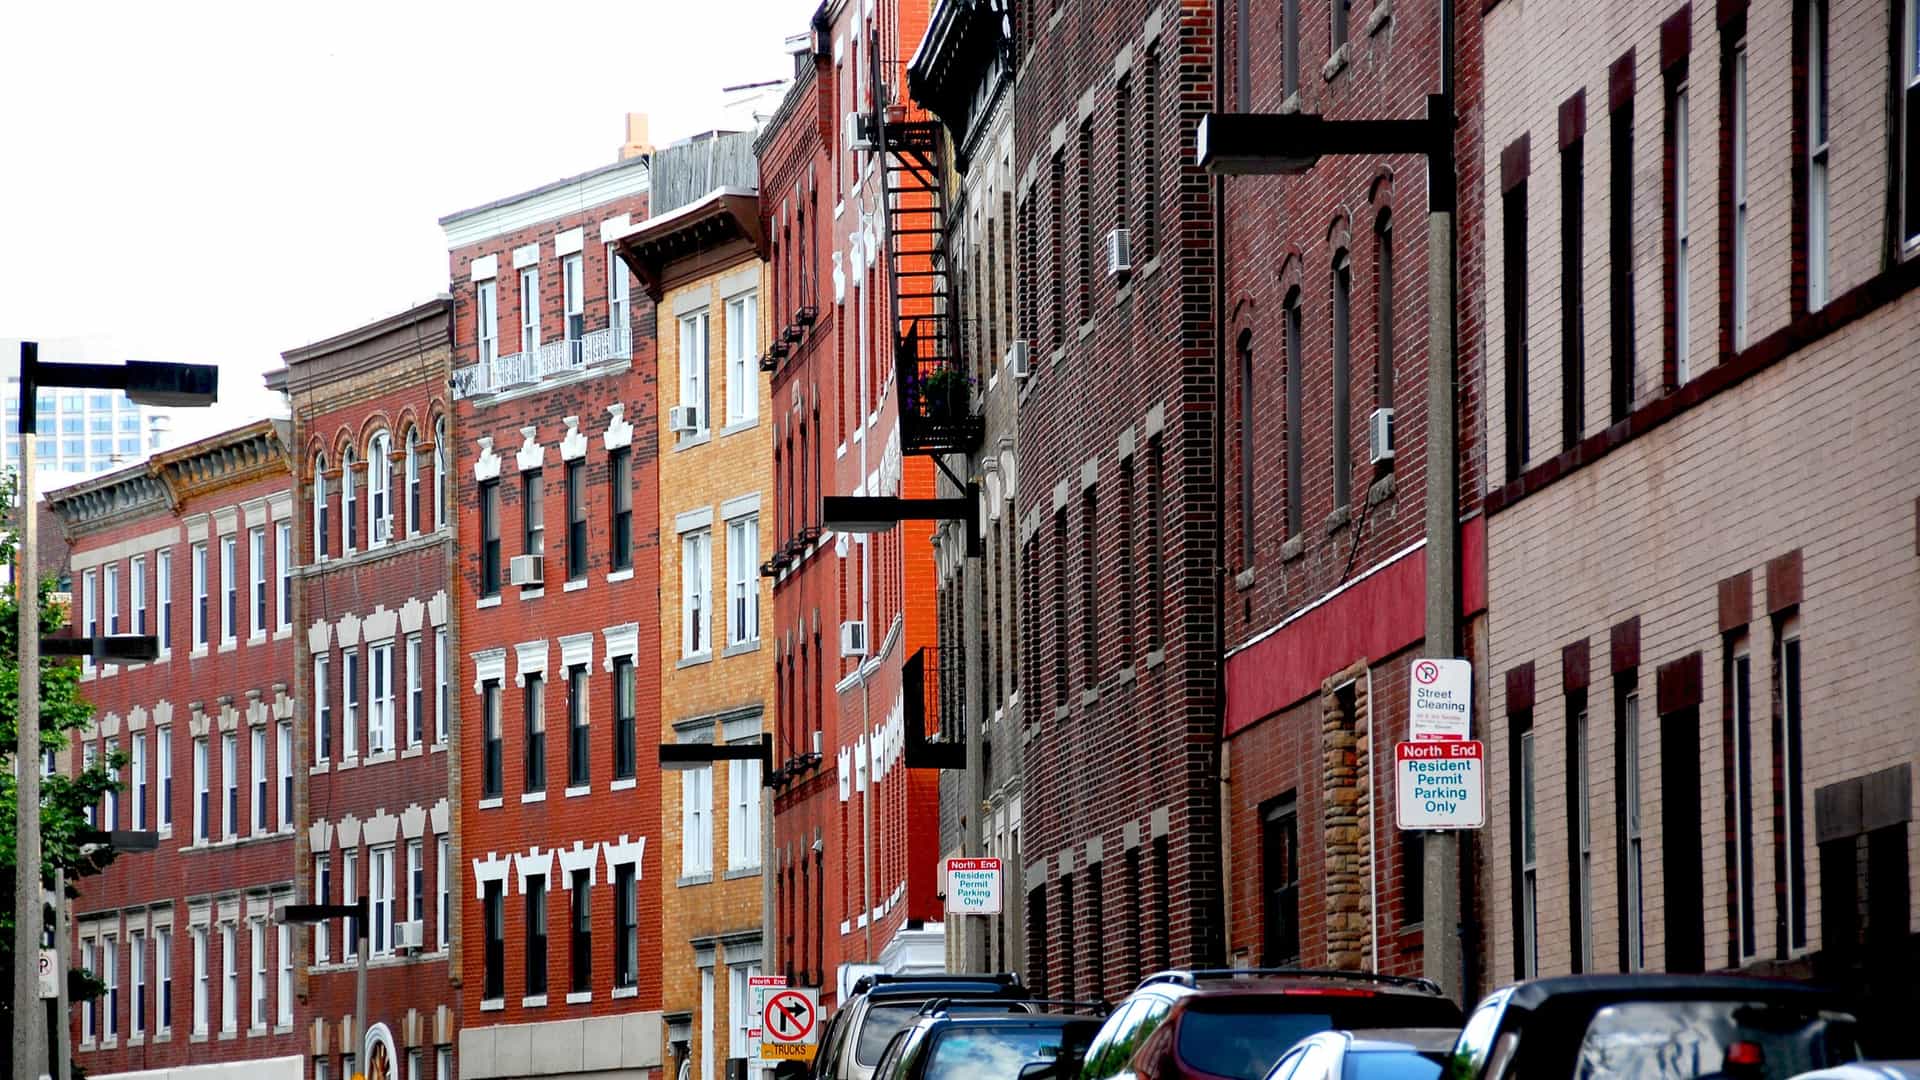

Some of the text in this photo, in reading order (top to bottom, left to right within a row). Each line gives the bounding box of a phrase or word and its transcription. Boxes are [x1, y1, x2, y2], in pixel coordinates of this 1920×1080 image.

[1417, 687, 1452, 699] Street
[1416, 700, 1466, 712] Cleaning
[1403, 744, 1477, 757] North End
[1408, 760, 1471, 772] Resident
[1417, 773, 1463, 785] Permit
[1414, 787, 1467, 800] Parking
[1425, 801, 1457, 814] Only
[951, 860, 997, 869] North End
[959, 880, 988, 888] Permit
[957, 889, 991, 897] Parking
[963, 897, 984, 906] Only
[774, 1044, 807, 1055] TRUCKS
